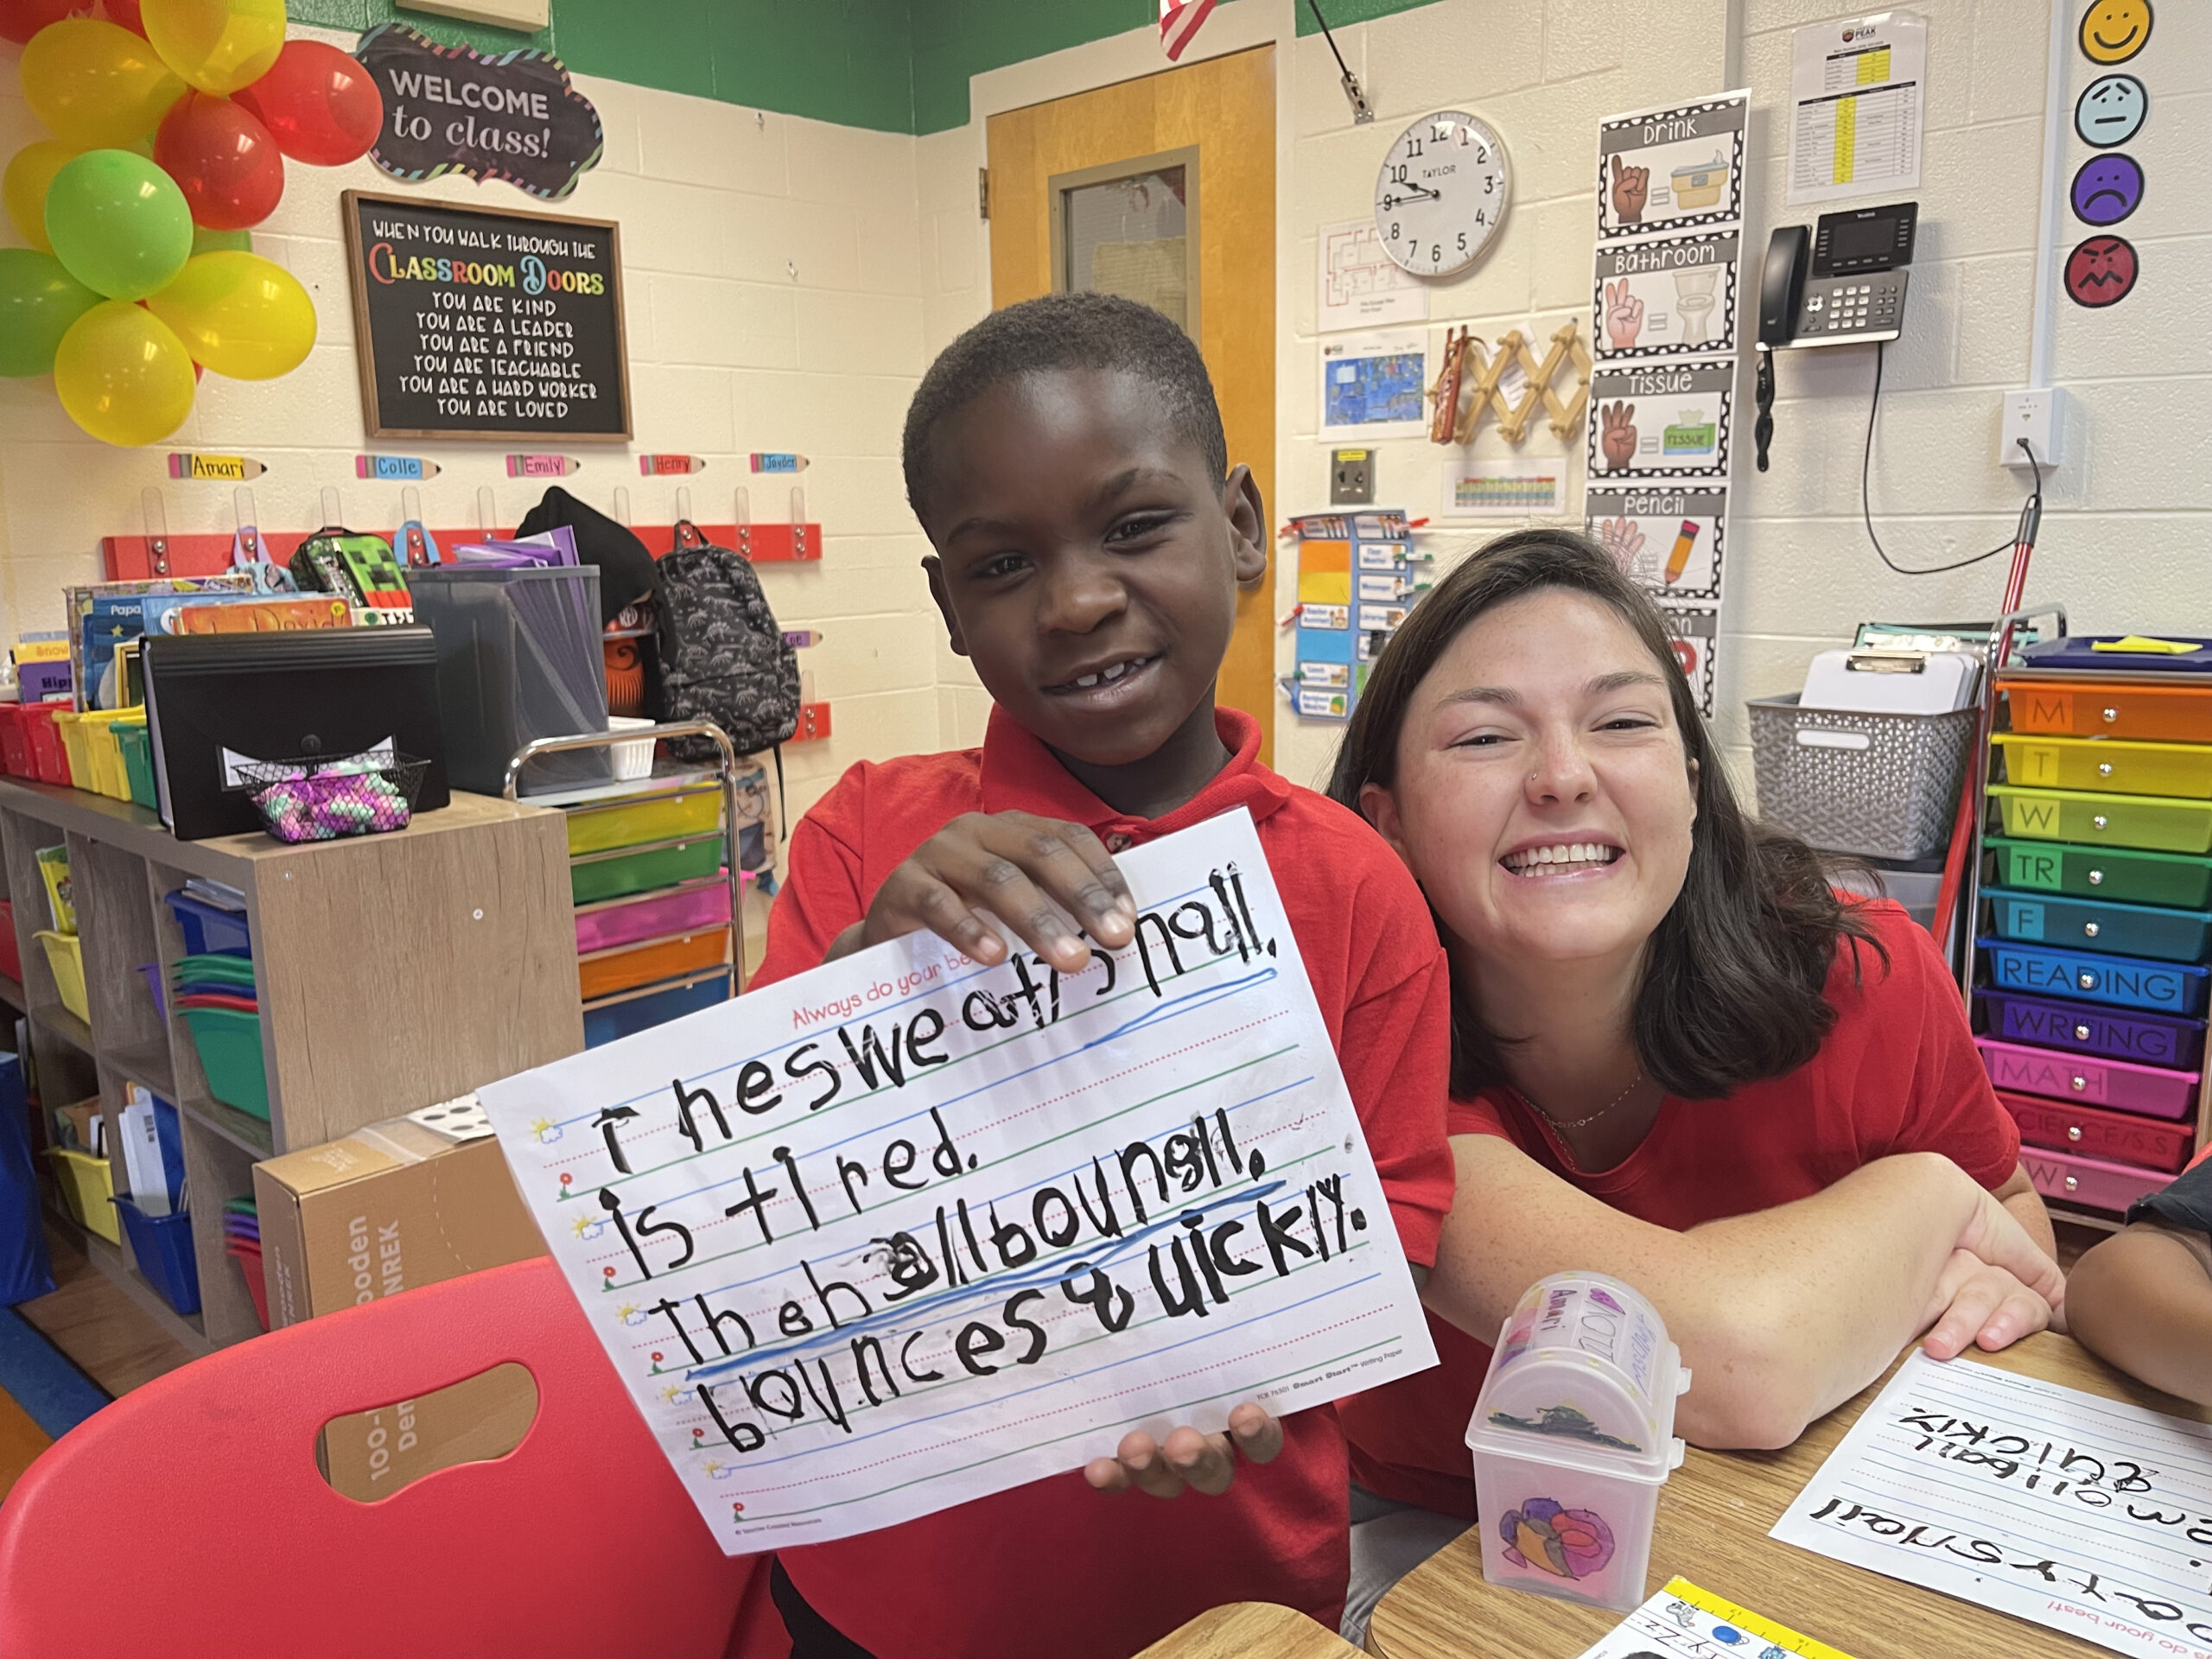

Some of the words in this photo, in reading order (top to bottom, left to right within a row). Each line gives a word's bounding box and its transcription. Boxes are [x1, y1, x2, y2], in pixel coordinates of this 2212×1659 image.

[390, 68, 550, 119] WELCOME
[391, 105, 432, 141] to
[446, 114, 551, 158] class!
[1643, 117, 1697, 145] Drink
[1407, 139, 1423, 158] 11
[1477, 146, 1486, 164] 2
[1390, 164, 1408, 183] 10
[1422, 165, 1456, 178] TAYLOR
[1484, 175, 1493, 194] 3
[1476, 208, 1484, 226] 4
[372, 219, 419, 240] WHEN
[423, 225, 454, 245] YOU
[458, 229, 502, 249] WALK
[507, 234, 569, 256] THROUGH
[573, 241, 596, 259] THE
[1391, 222, 1400, 239] 8
[1458, 232, 1466, 251] 5
[1409, 239, 1417, 257] 7
[1432, 245, 1441, 262] 6
[1615, 243, 1715, 275] Bathroom
[432, 291, 467, 311] YOU
[473, 295, 504, 314] ARE
[512, 299, 556, 317] KIND
[416, 312, 449, 331] YOU
[456, 315, 486, 334] ARE
[493, 319, 505, 334] A
[511, 319, 574, 338] LEADER
[420, 334, 454, 353] YOU
[460, 337, 490, 354] ARE
[496, 340, 507, 355] A
[513, 340, 574, 359] FRIEND
[414, 355, 447, 373] YOU
[453, 358, 483, 374] ARE
[491, 359, 582, 379] TEACHABLE
[399, 376, 432, 393] YOU
[439, 378, 469, 395] ARE
[475, 380, 487, 396] A
[493, 381, 534, 397] HARD
[539, 382, 598, 399] WORKER
[1628, 372, 1692, 396] Tissue
[436, 398, 471, 416] YOU
[477, 399, 507, 417] ARE
[515, 401, 569, 418] LOVED
[1667, 433, 1707, 448] TISSUE
[193, 457, 245, 477] Amari
[524, 455, 562, 475] Emily
[657, 454, 690, 474] Henry
[1624, 495, 1684, 515] Pencil
[111, 605, 142, 616] Papa
[2033, 697, 2065, 724] M
[2033, 751, 2050, 778] T
[2019, 803, 2054, 830] W
[2017, 855, 2055, 883] TR
[2018, 909, 2033, 933] F
[792, 995, 862, 1029] Always
[867, 982, 893, 1001] do
[898, 964, 942, 995] your
[944, 953, 972, 971] be
[2004, 957, 2177, 1001] READING
[347, 1216, 373, 1306] ooden
[378, 1219, 404, 1297] NREK
[2047, 1599, 2100, 1624] best!
[2105, 1620, 2155, 1642] your
